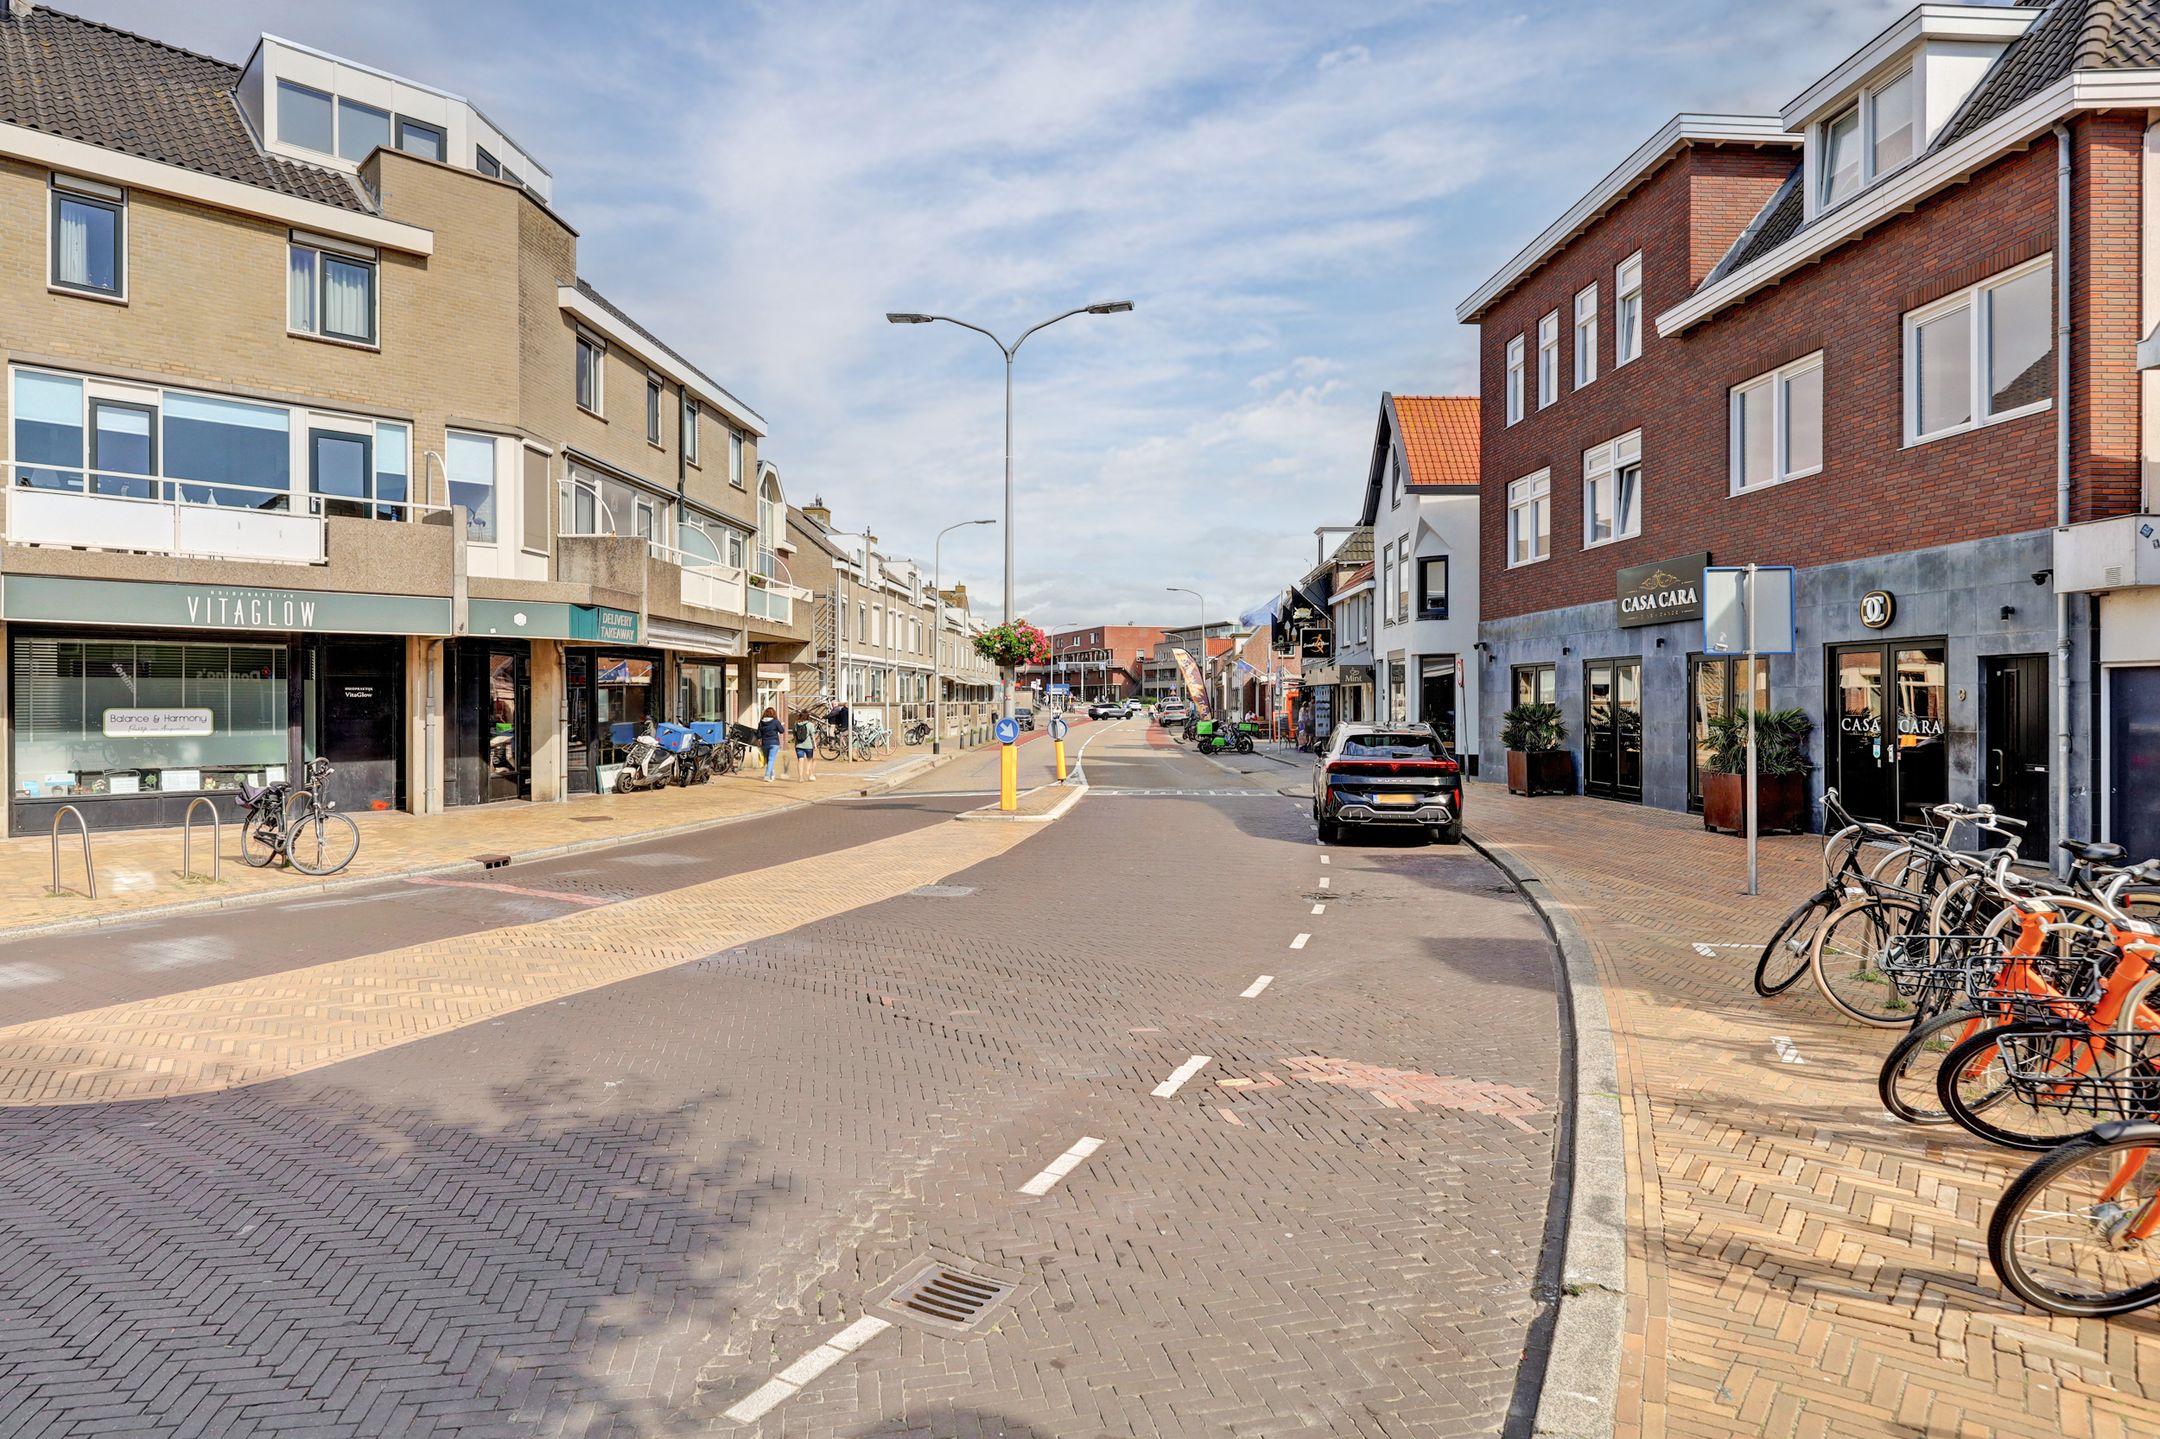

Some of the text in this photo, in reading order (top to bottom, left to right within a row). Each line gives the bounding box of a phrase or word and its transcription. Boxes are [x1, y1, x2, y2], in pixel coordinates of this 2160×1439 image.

[1621, 587, 1698, 613] CASA CARA
[187, 596, 315, 627] VITAGLOW
[603, 613, 632, 626] DELIVERY
[601, 627, 634, 640] TAKEAWAY
[1345, 674, 1362, 682] Mint
[110, 714, 150, 723] Balance
[164, 714, 208, 724] Harmony
[1841, 718, 1942, 734] CASA CARA
